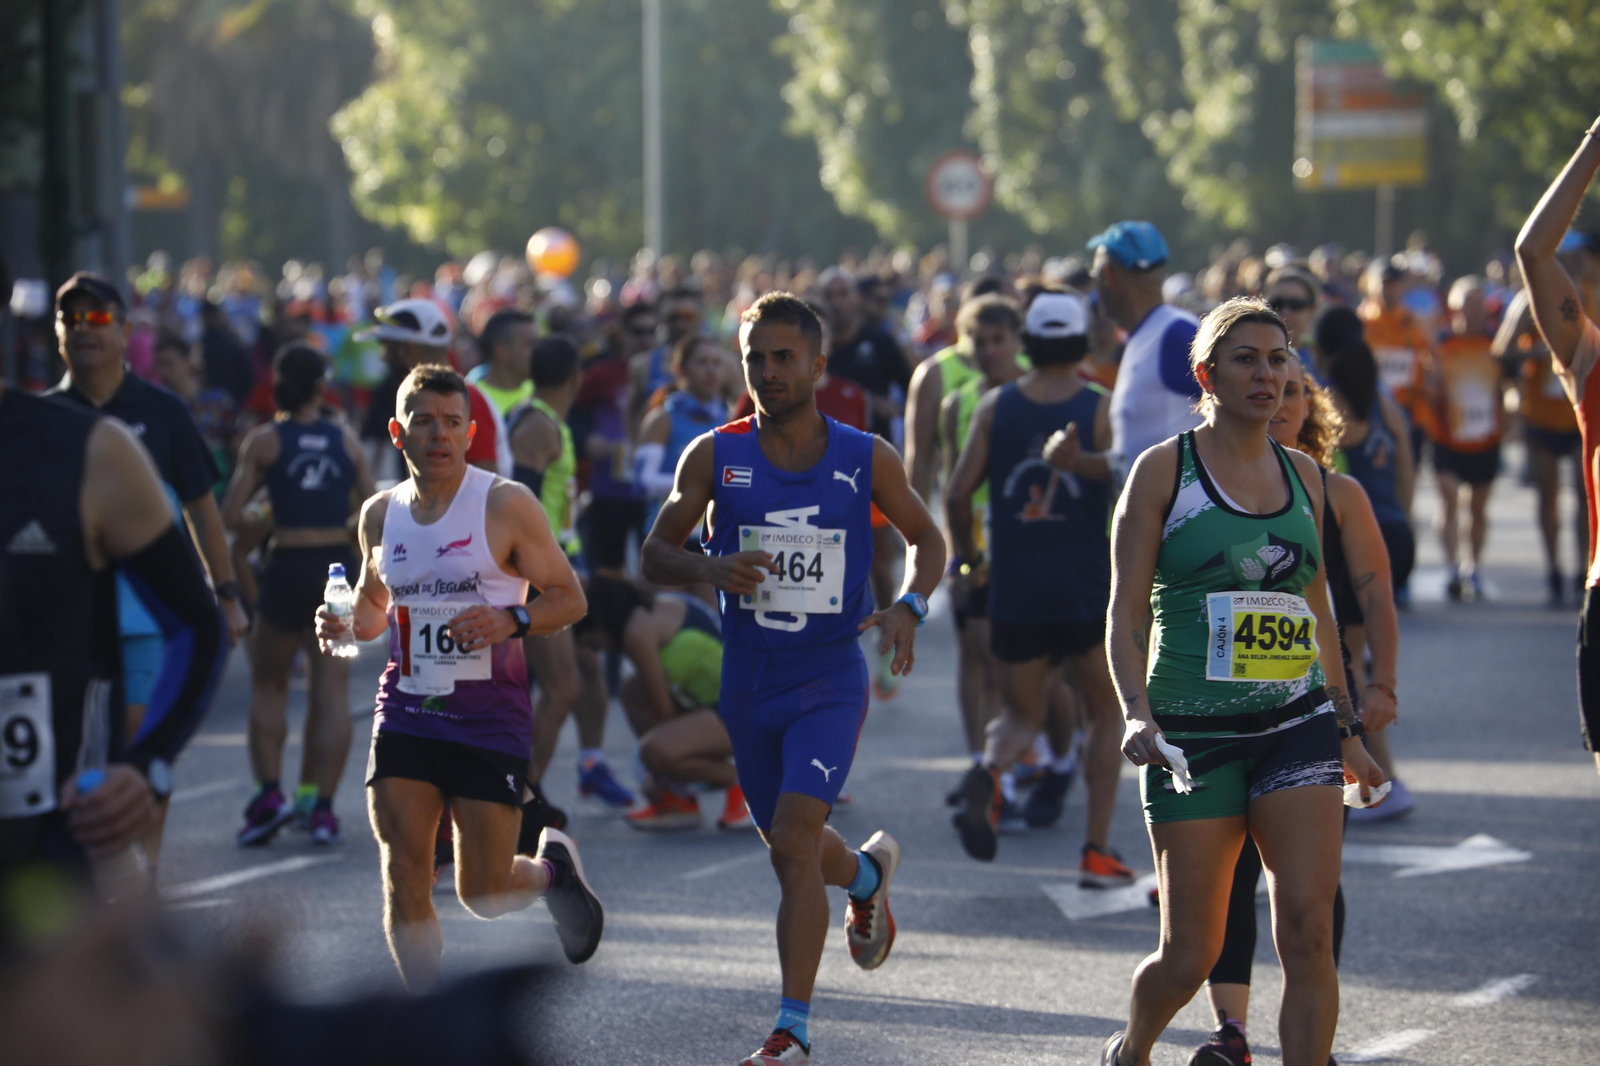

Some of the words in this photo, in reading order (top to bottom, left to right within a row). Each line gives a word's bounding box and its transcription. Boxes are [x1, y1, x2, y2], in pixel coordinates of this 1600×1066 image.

[772, 533, 814, 545] IMDECO
[754, 505, 820, 632] CA
[769, 550, 824, 583] 464
[421, 584, 433, 593] DE
[431, 578, 478, 598] SEGURA
[419, 607, 457, 617] IMDECO
[1246, 597, 1286, 607] IMDECO
[1216, 624, 1227, 659] CAJÓN
[1233, 614, 1312, 651] 4594
